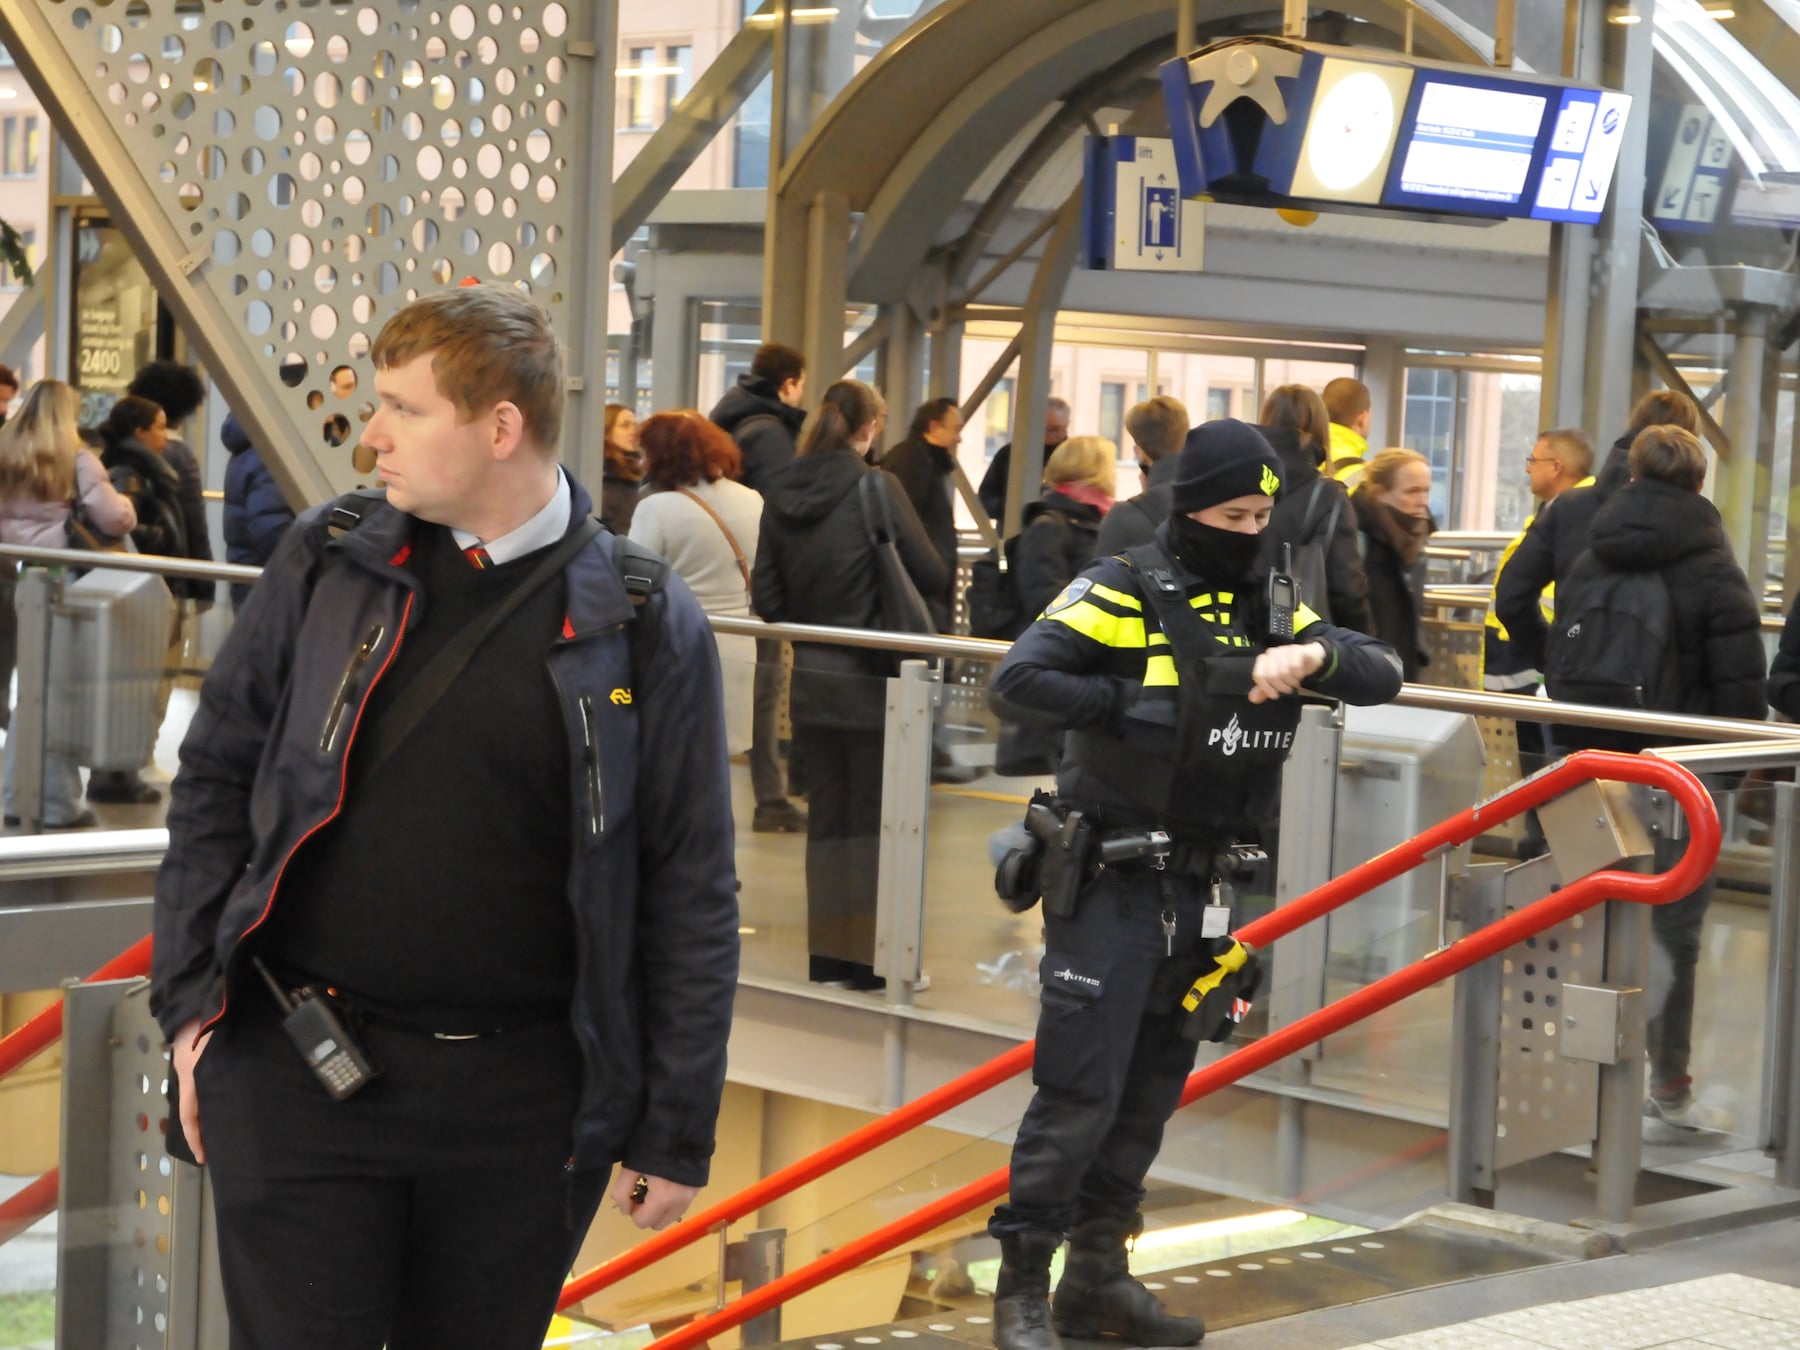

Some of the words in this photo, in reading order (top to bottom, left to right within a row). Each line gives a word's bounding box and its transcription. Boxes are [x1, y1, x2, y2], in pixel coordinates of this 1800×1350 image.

[1138, 146, 1153, 159] lift
[81, 349, 120, 373] 2400
[1208, 718, 1292, 756] POLITIE
